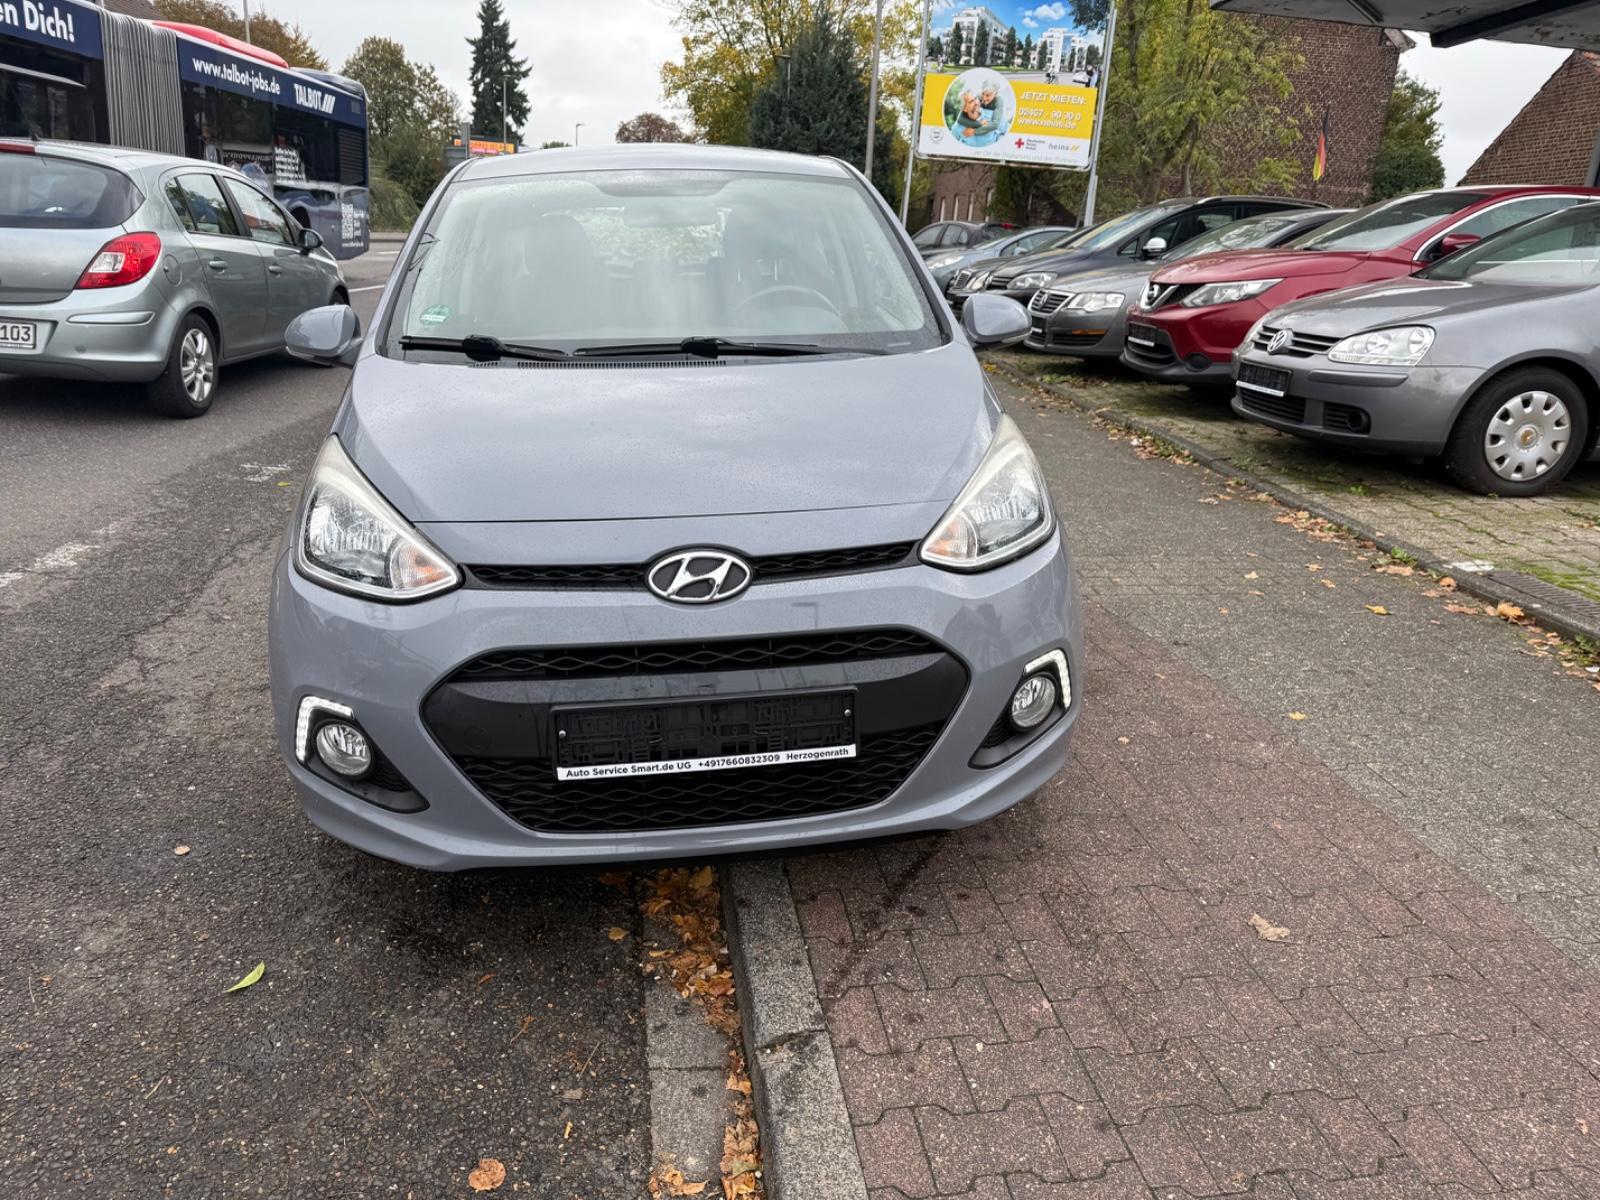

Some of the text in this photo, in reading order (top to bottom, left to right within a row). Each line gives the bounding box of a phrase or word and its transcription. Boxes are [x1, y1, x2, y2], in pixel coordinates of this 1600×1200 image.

[22, 0, 75, 43] Dich!
[192, 58, 281, 95] www.talbot-jobs.de
[294, 83, 323, 111] TALBOT
[1020, 91, 1048, 102] JETZT
[566, 747, 849, 779] Auto Service Smart.de UG +4917660832309 Herzogenrath
